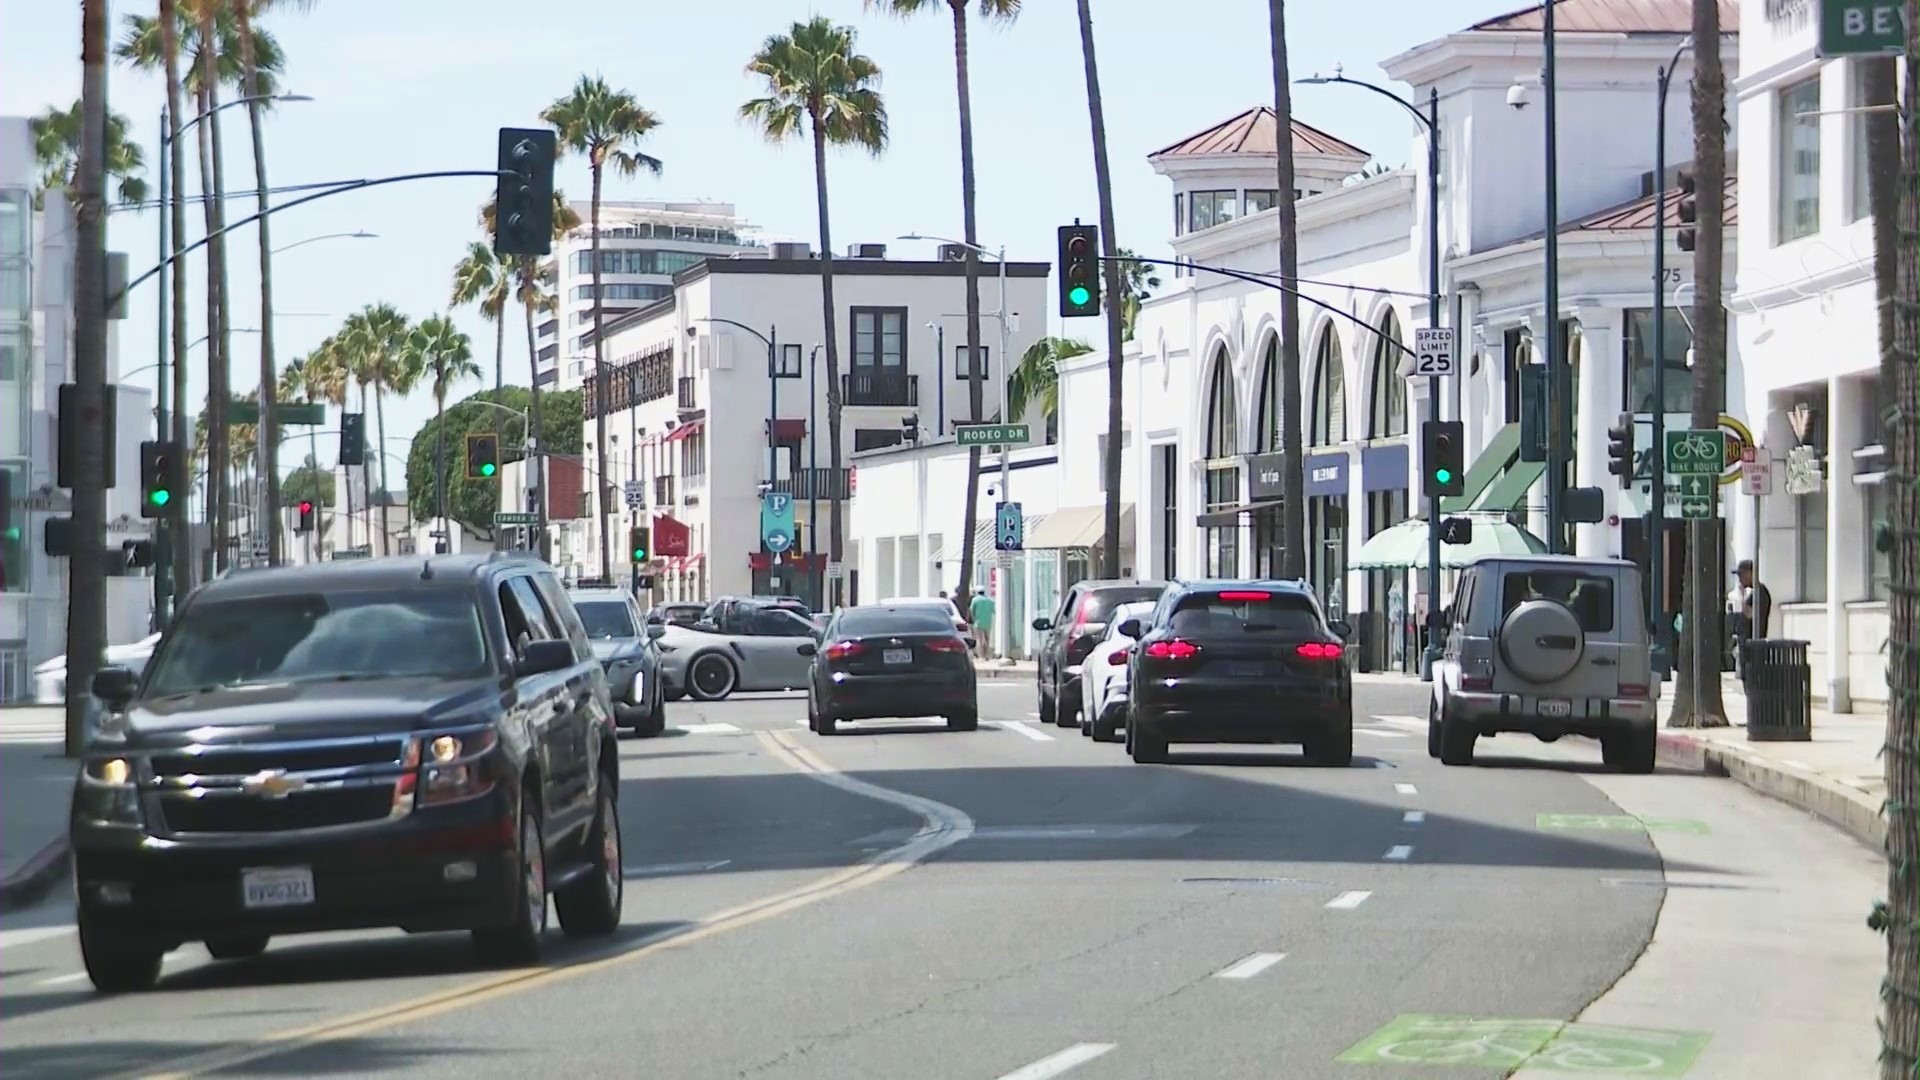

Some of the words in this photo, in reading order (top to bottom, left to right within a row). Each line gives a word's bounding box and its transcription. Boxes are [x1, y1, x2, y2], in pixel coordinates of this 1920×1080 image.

[1418, 332, 1451, 340] SPEED
[1421, 343, 1448, 351] LIMIT
[1420, 354, 1450, 372] 25
[964, 430, 1001, 440] RODEO
[1008, 429, 1024, 439] DR
[1670, 462, 1689, 471] BIKE
[1694, 462, 1720, 471] ROUTE
[627, 493, 643, 503] 25
[773, 496, 786, 511] P
